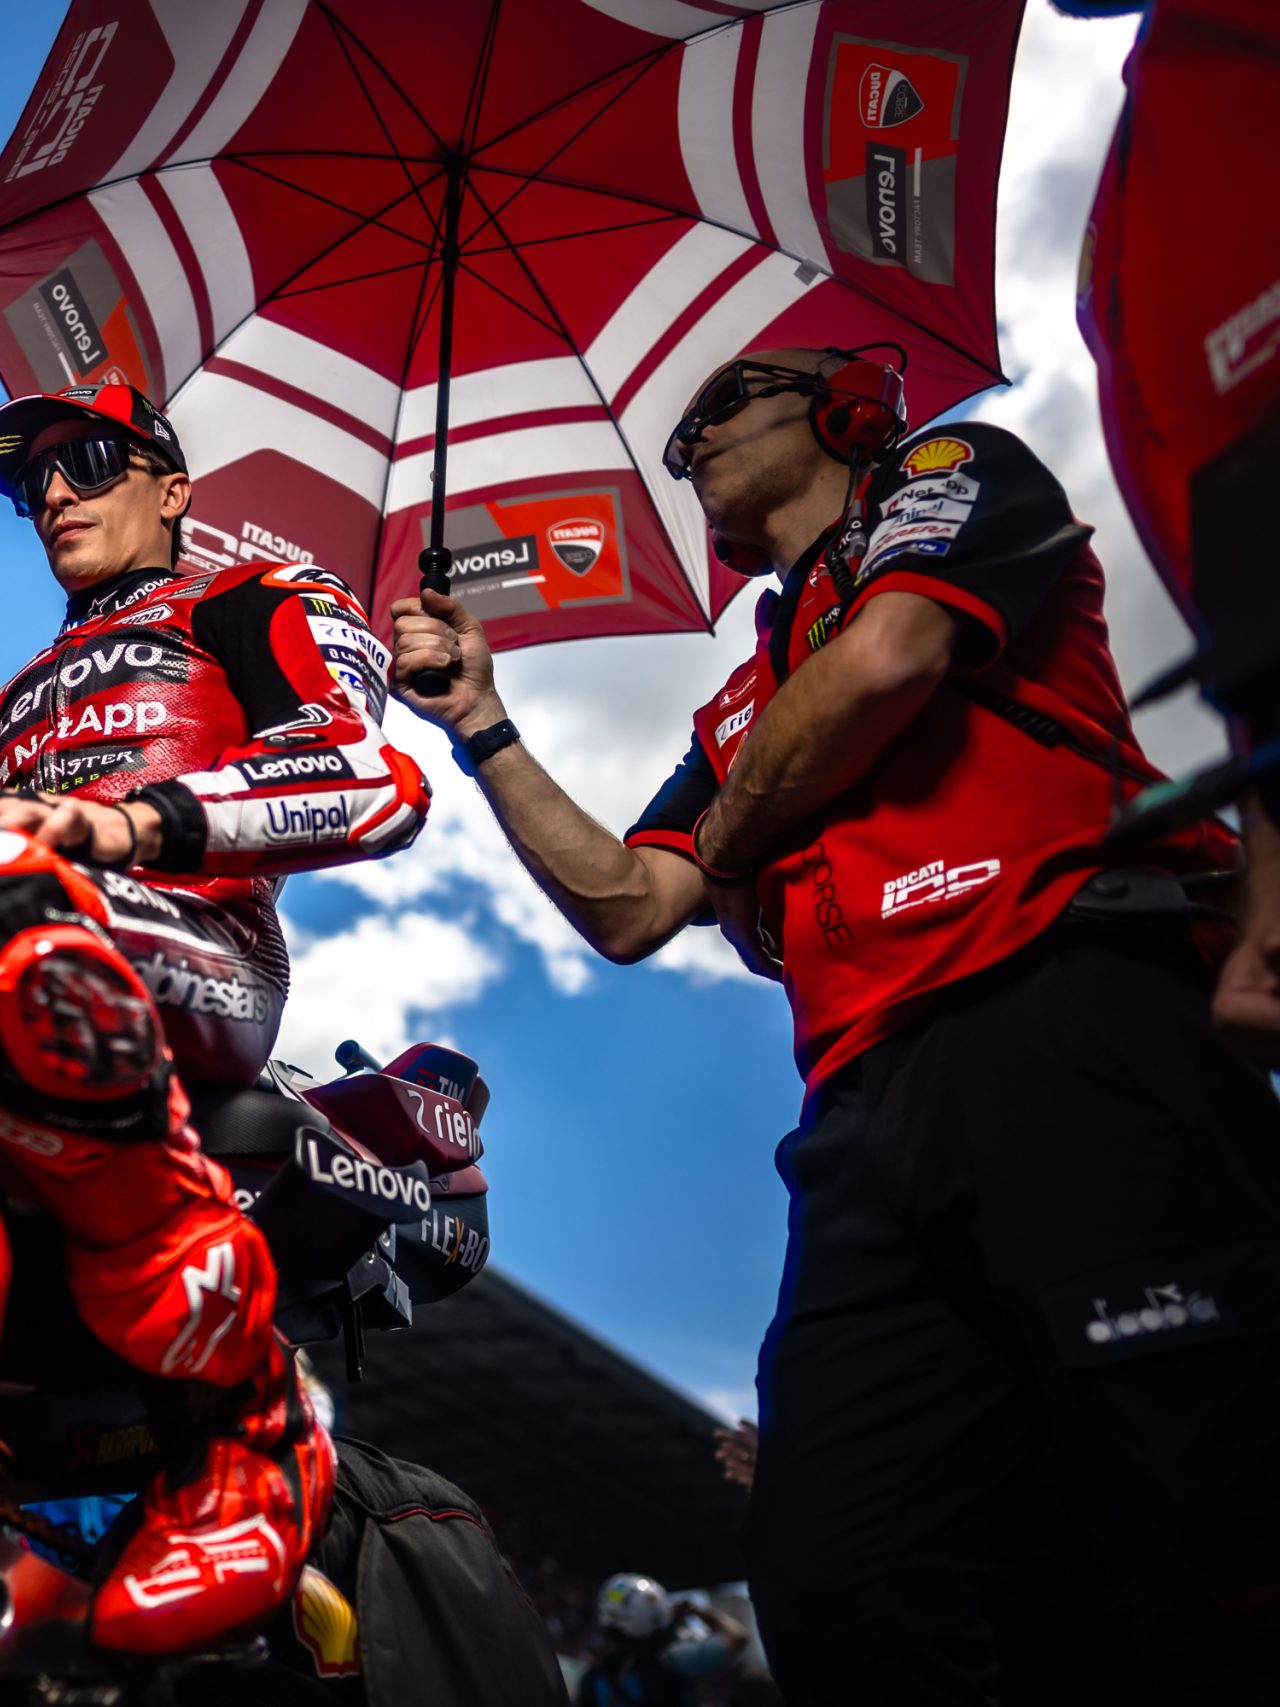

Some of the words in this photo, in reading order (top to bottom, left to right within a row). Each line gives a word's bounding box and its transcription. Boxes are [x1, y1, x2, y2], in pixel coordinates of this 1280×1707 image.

[59, 389, 94, 398] enovo
[901, 479, 969, 502] Netpp
[115, 577, 174, 611] Lenovo
[124, 604, 167, 625] HOEI
[341, 628, 386, 669] riello
[244, 752, 343, 781] Lenovo
[266, 796, 349, 837] Unipol
[883, 860, 945, 894] DUCATI
[801, 842, 855, 949] CORSE
[438, 1075, 467, 1101] TIM
[307, 1139, 432, 1213] Lenovo
[421, 1208, 489, 1273] FLEX-BO
